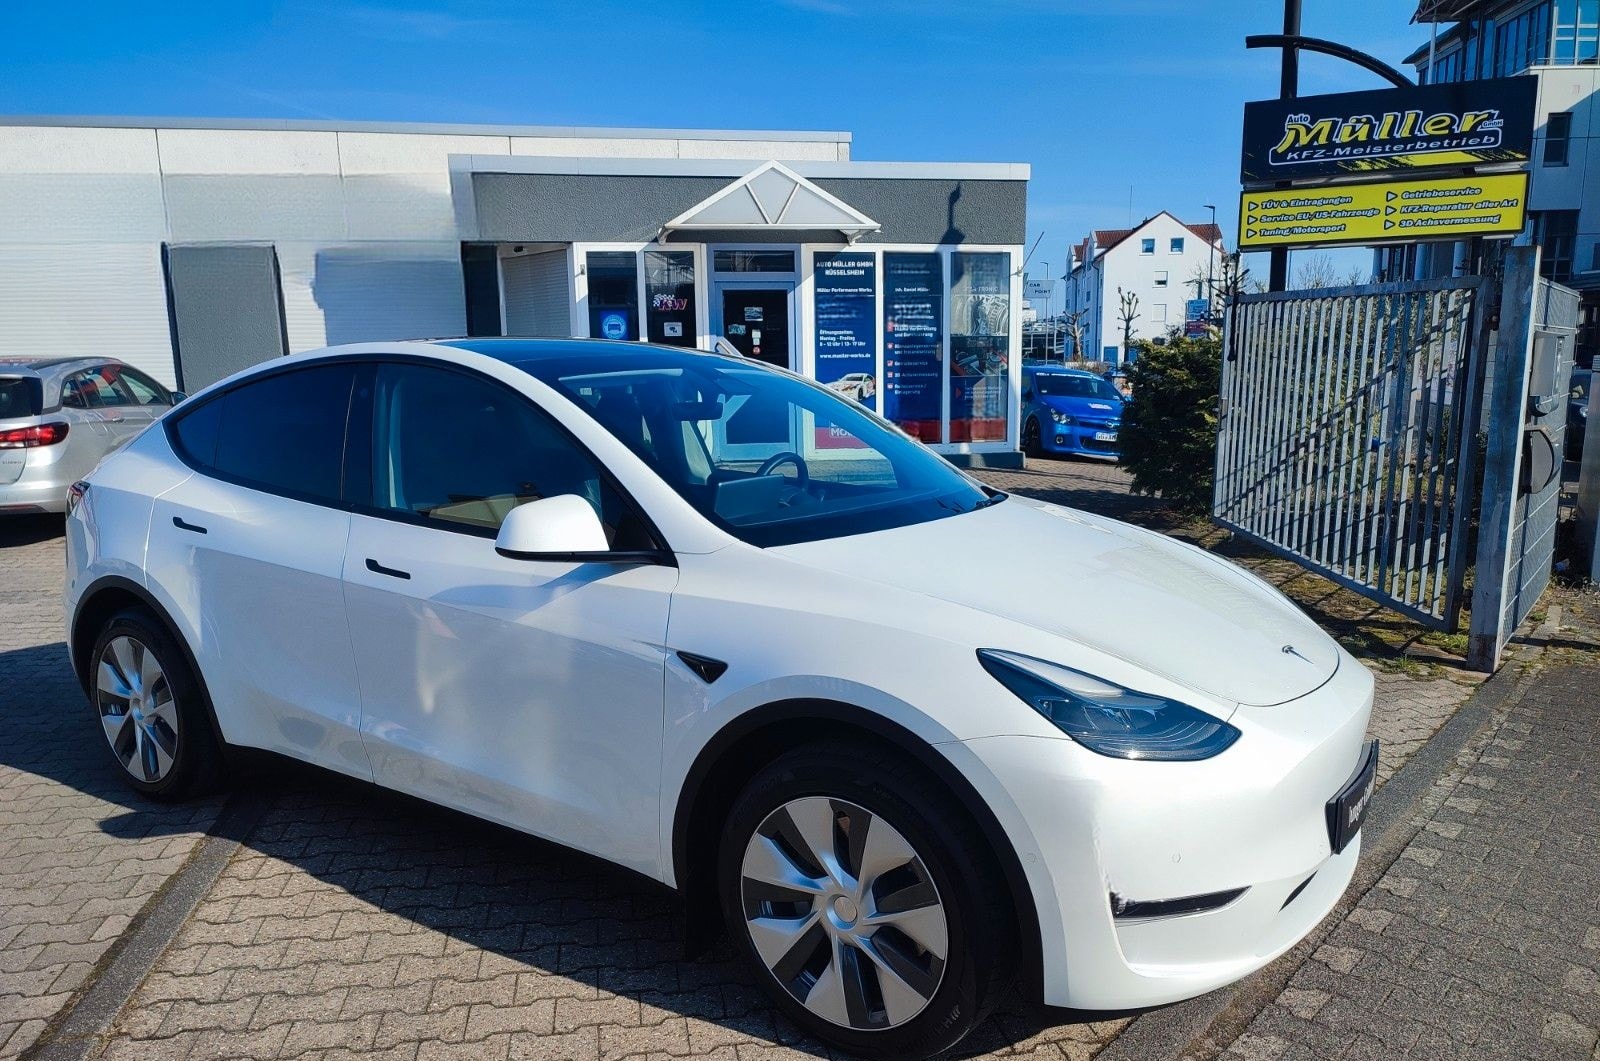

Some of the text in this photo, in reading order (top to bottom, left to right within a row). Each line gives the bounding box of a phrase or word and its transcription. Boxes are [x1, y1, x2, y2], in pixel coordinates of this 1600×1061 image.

[1287, 113, 1309, 124] Auto
[1482, 118, 1503, 129] GmbH
[1276, 111, 1494, 154] Müller
[1286, 135, 1495, 161] KFZ-Meisterbetrieb
[1401, 187, 1482, 200] Getriebeservice
[1261, 196, 1353, 209] TÜV & Eintragungen
[1400, 198, 1518, 214] KFZ-Reparatur aller Art
[1260, 208, 1380, 223] Service EU-/US-Fahrzeuge
[1399, 214, 1501, 228] 3D Achsvermessung
[1260, 224, 1346, 237] Tuning/Motorsport
